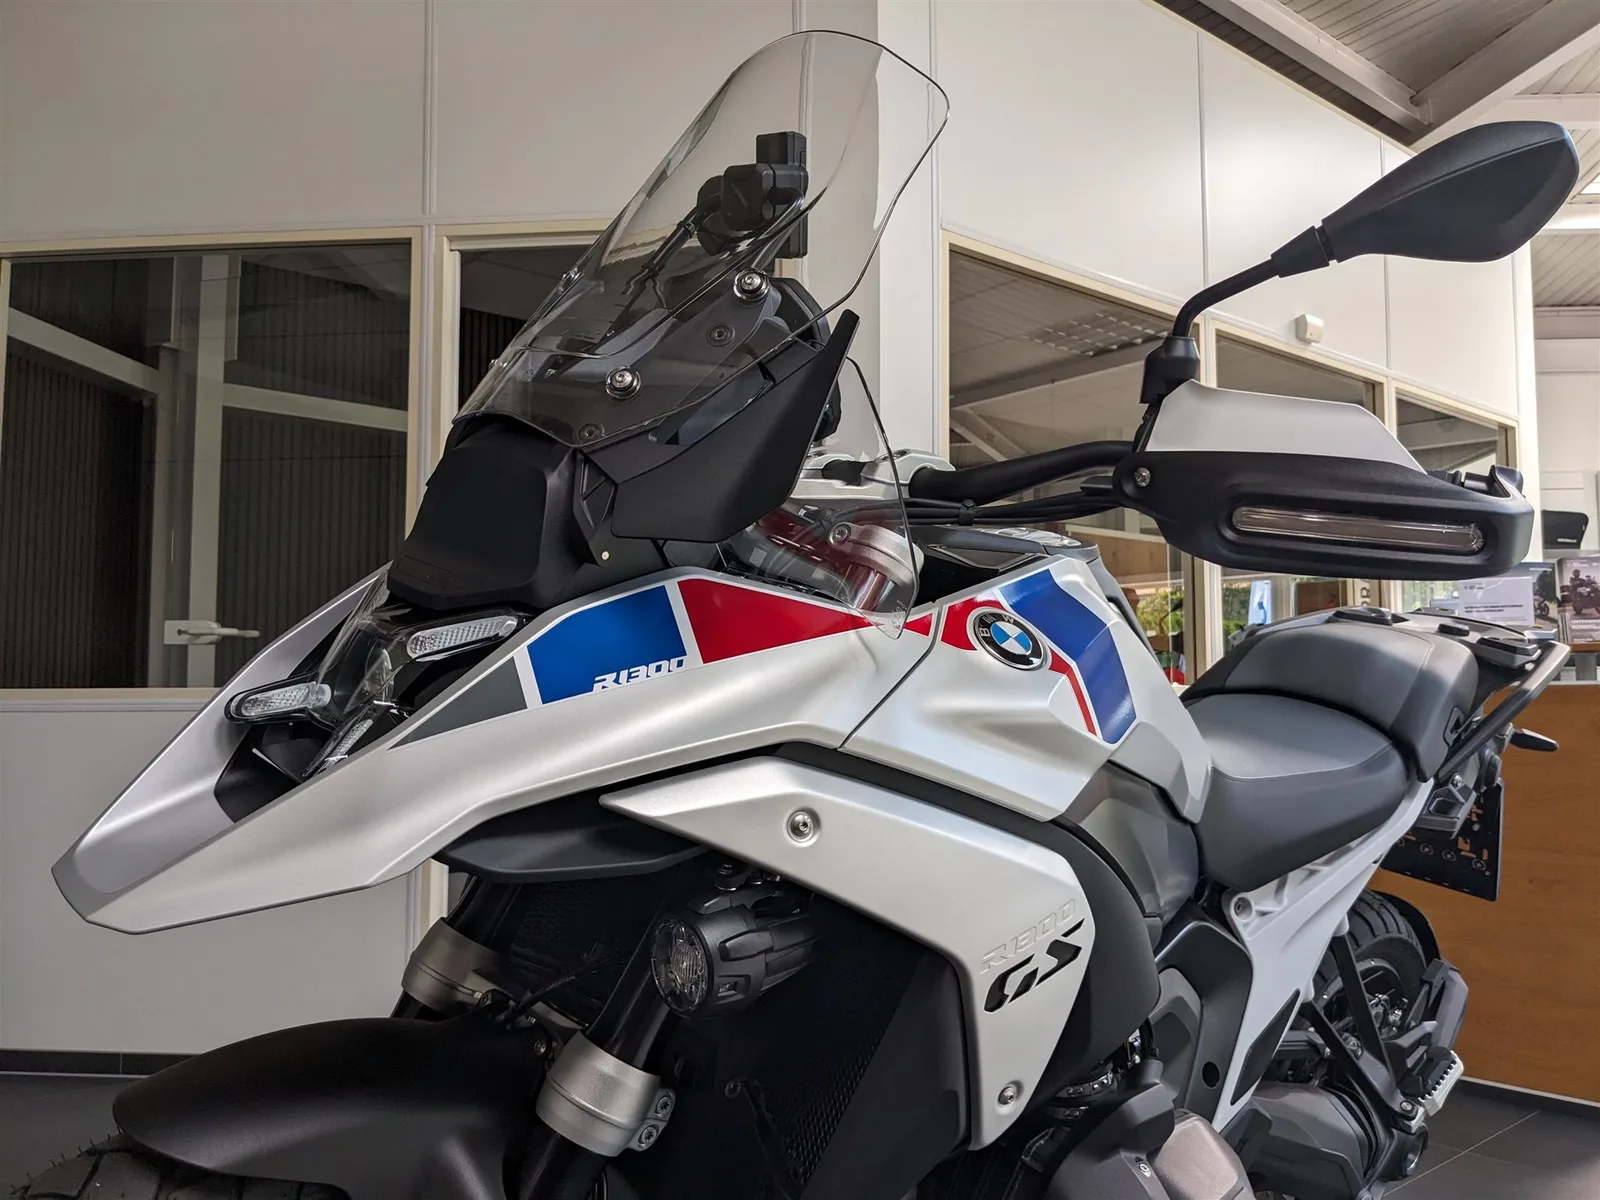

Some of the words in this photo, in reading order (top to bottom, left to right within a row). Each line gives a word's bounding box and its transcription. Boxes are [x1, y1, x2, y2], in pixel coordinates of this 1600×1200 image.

[980, 613, 1014, 637] BMW
[592, 656, 688, 693] R1300
[983, 917, 1085, 1014] GS
